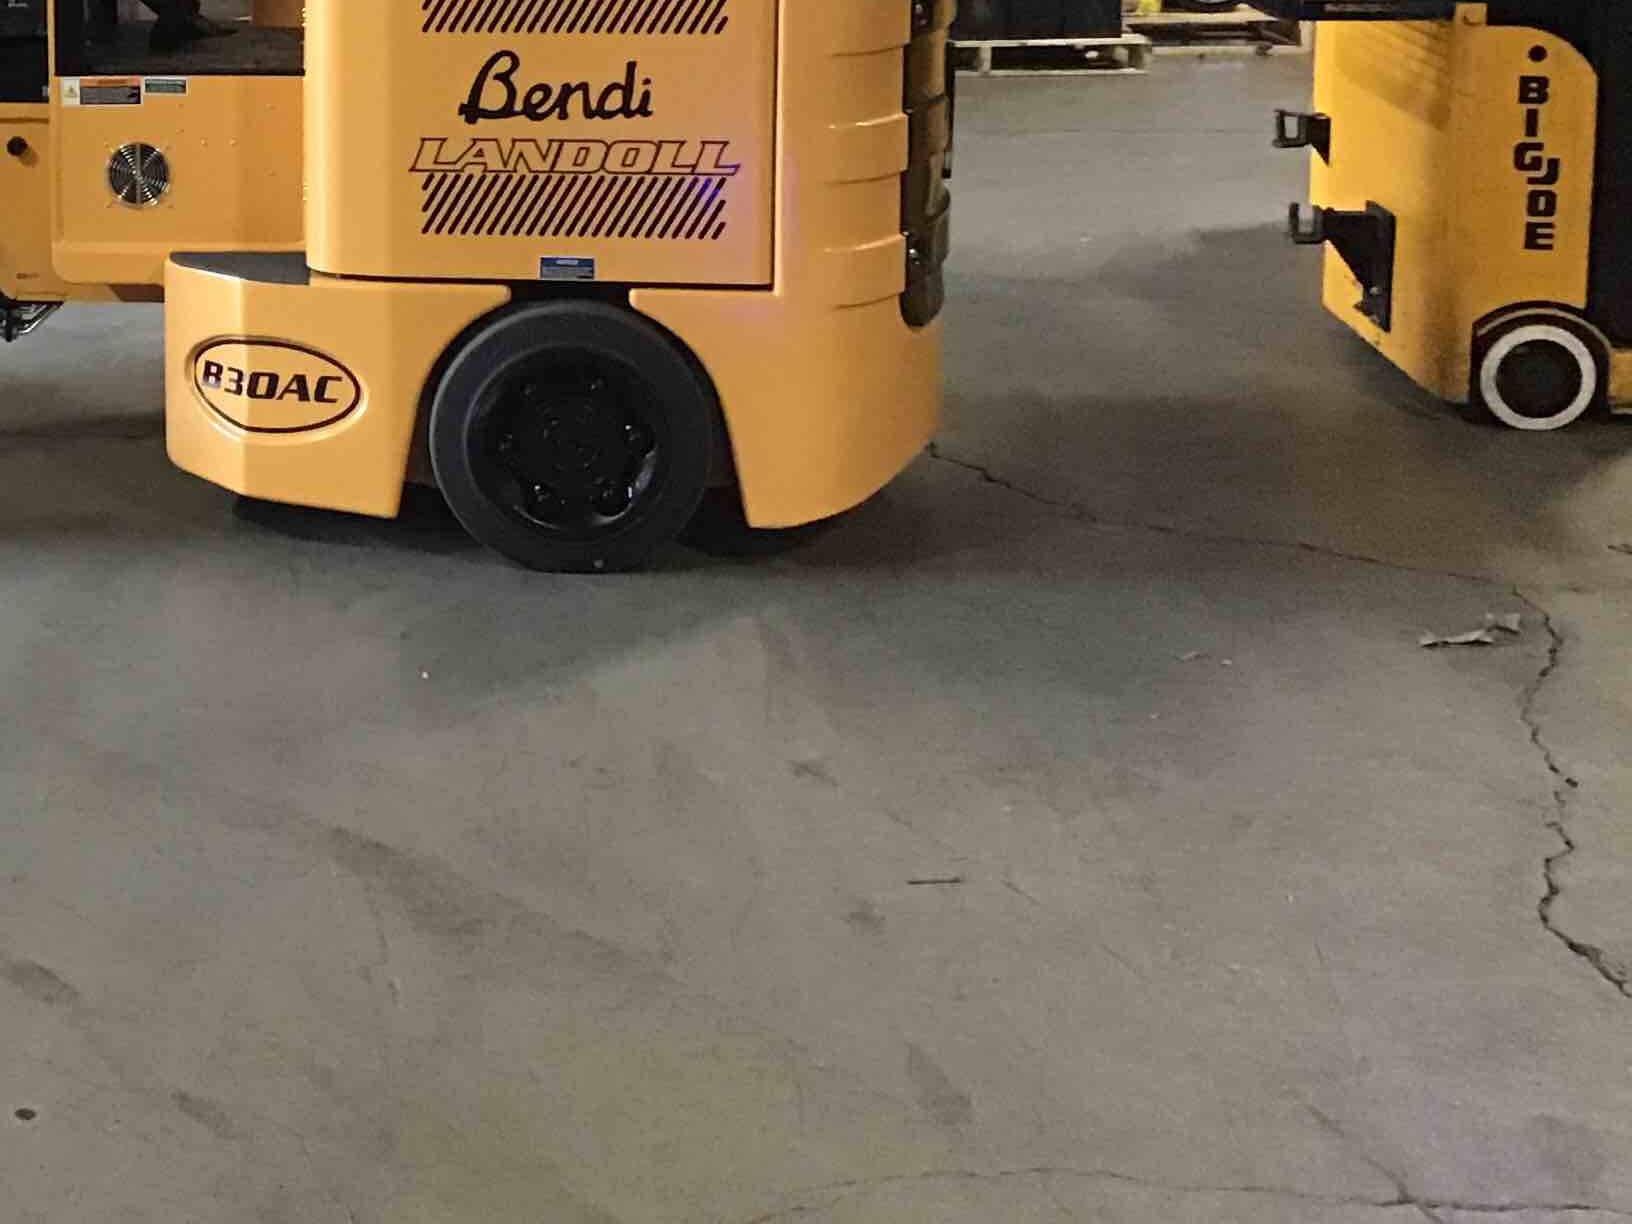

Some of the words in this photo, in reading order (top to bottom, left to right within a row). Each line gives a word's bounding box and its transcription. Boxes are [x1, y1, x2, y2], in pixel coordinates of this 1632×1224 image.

[458, 49, 654, 125] Bendi
[408, 136, 741, 176] LANDOLL
[201, 359, 343, 404] B30AC
